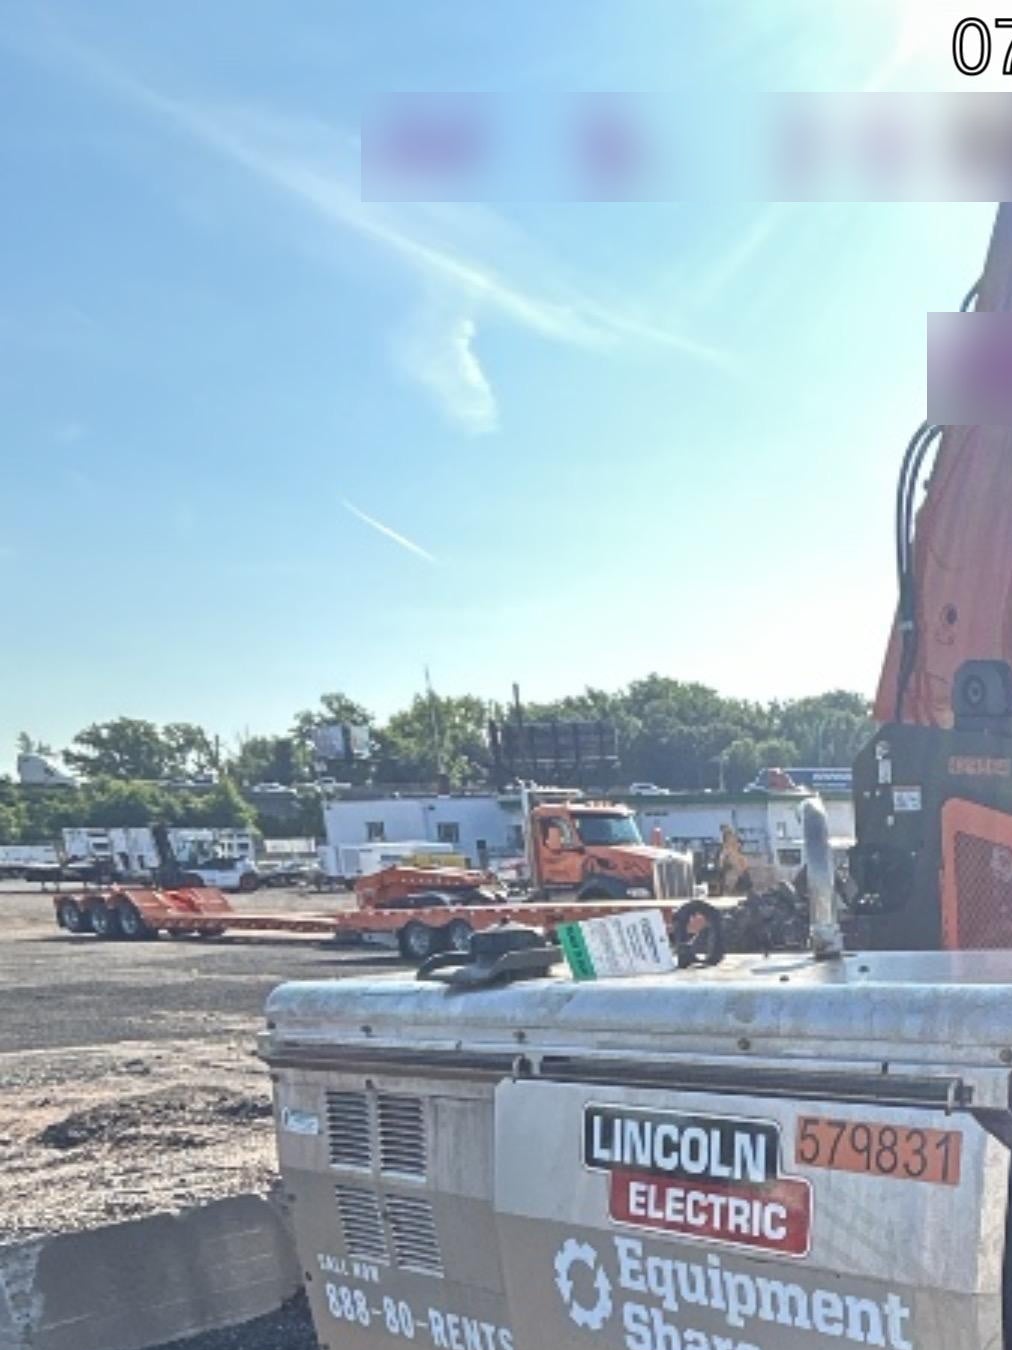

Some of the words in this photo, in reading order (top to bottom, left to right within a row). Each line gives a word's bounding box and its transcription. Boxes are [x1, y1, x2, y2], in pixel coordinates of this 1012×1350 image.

[592, 1115, 767, 1183] LINCOLN
[799, 1118, 952, 1183] 579831
[628, 1181, 788, 1241] ELECTRIC
